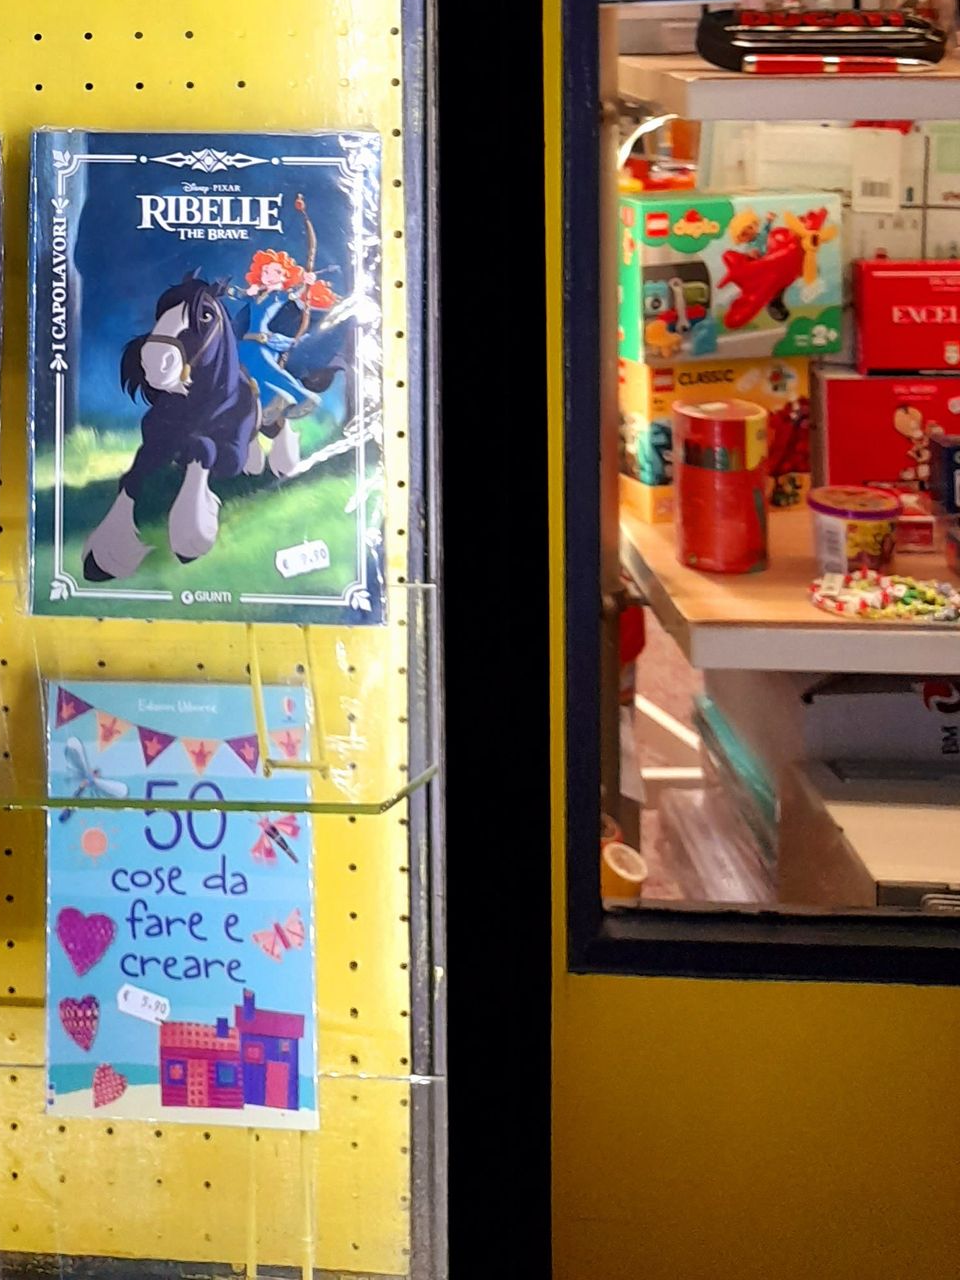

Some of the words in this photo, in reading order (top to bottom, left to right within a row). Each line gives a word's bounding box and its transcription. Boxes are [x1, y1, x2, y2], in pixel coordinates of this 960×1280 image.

[213, 184, 241, 192] PIXAR
[136, 193, 284, 234] RIBELLE
[177, 228, 205, 241] THE
[207, 228, 250, 241] BRAVE
[51, 216, 67, 340] CAPOLAVORI
[194, 591, 232, 603] GIUNTI
[144, 780, 227, 851] 50
[111, 866, 186, 896] cose
[203, 854, 248, 895] da
[125, 899, 208, 941] fare
[224, 913, 244, 943] e
[120, 953, 246, 984] creare
